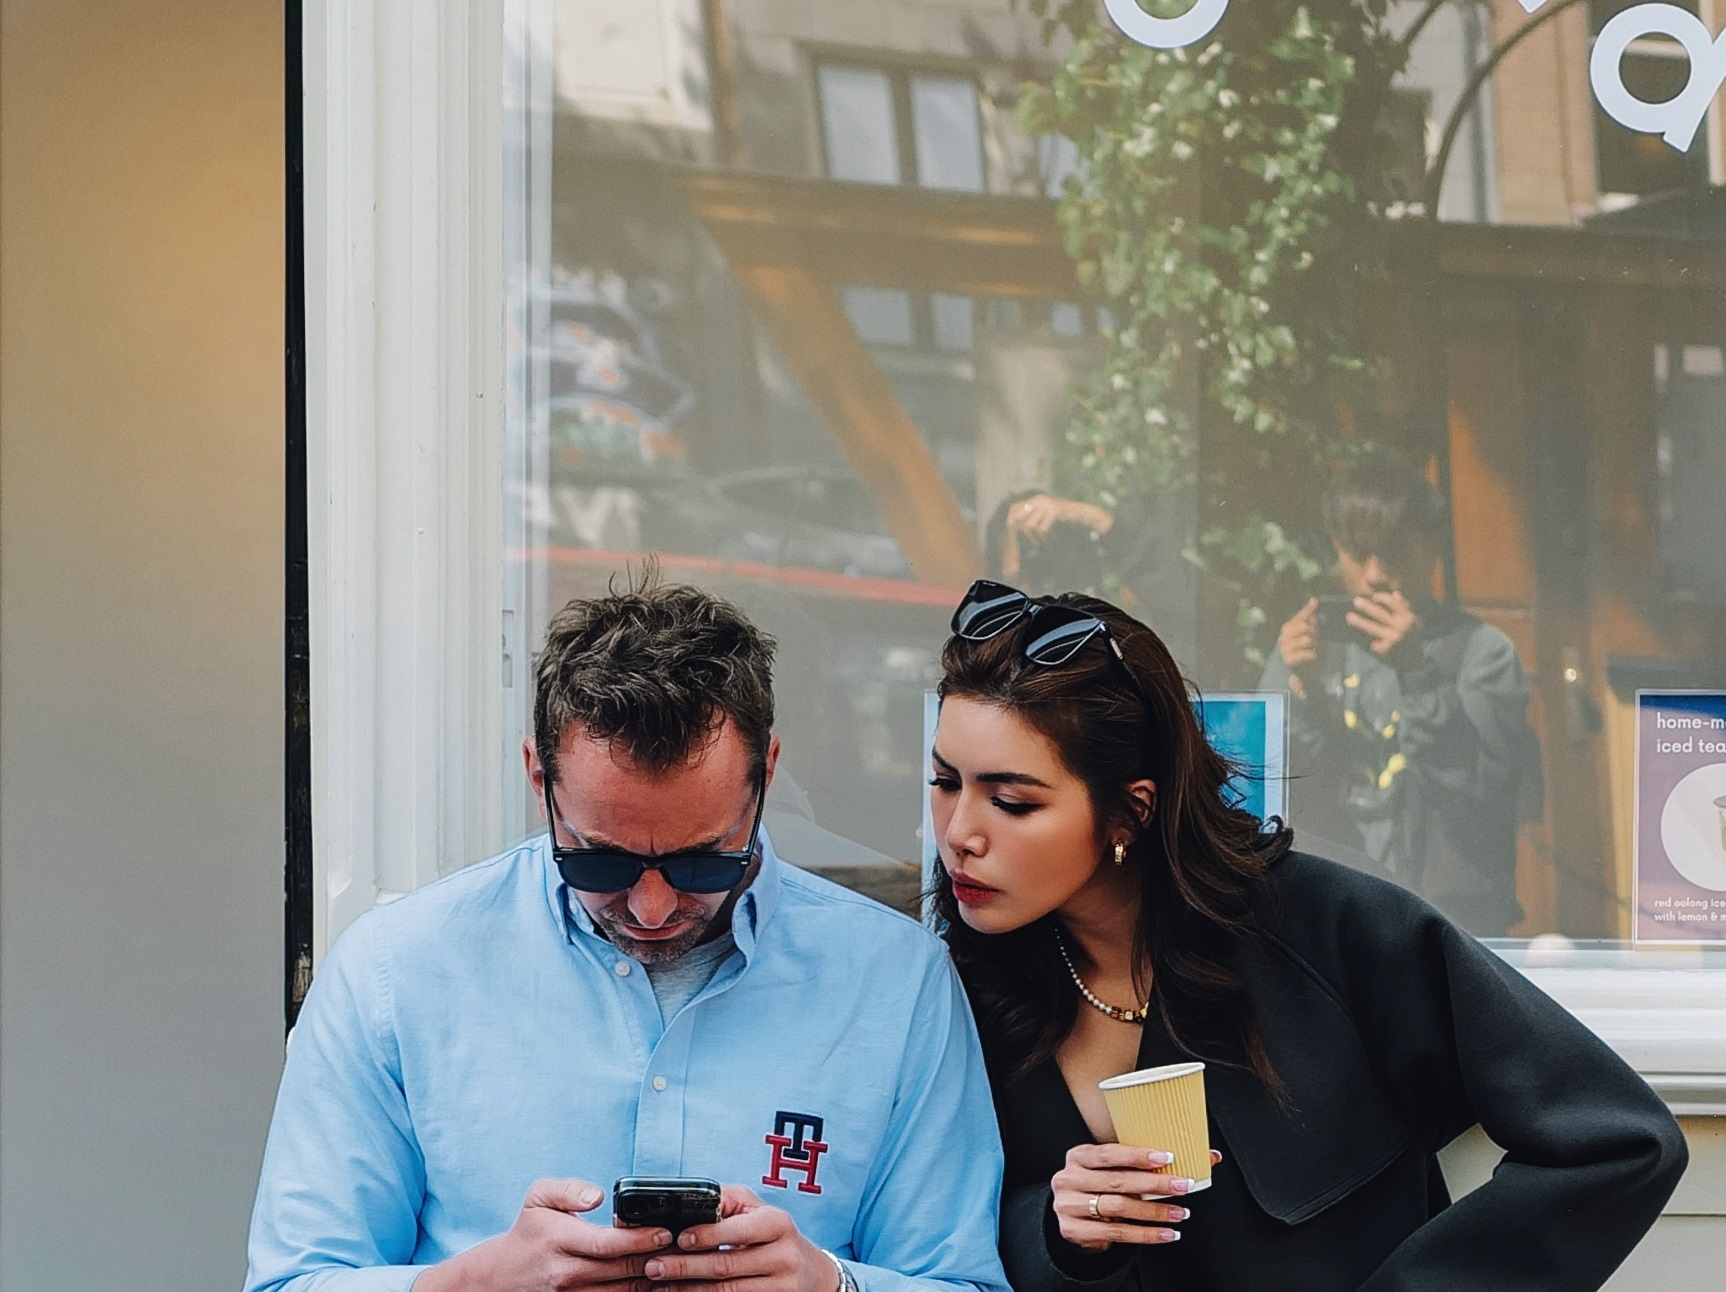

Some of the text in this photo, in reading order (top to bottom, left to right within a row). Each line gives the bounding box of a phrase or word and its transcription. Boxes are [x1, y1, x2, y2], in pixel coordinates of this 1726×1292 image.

[1656, 735, 1693, 753] iced
[1654, 896, 1672, 908] red
[1673, 896, 1708, 910] oolong
[1654, 910, 1676, 921] with
[1677, 910, 1708, 921] lemon
